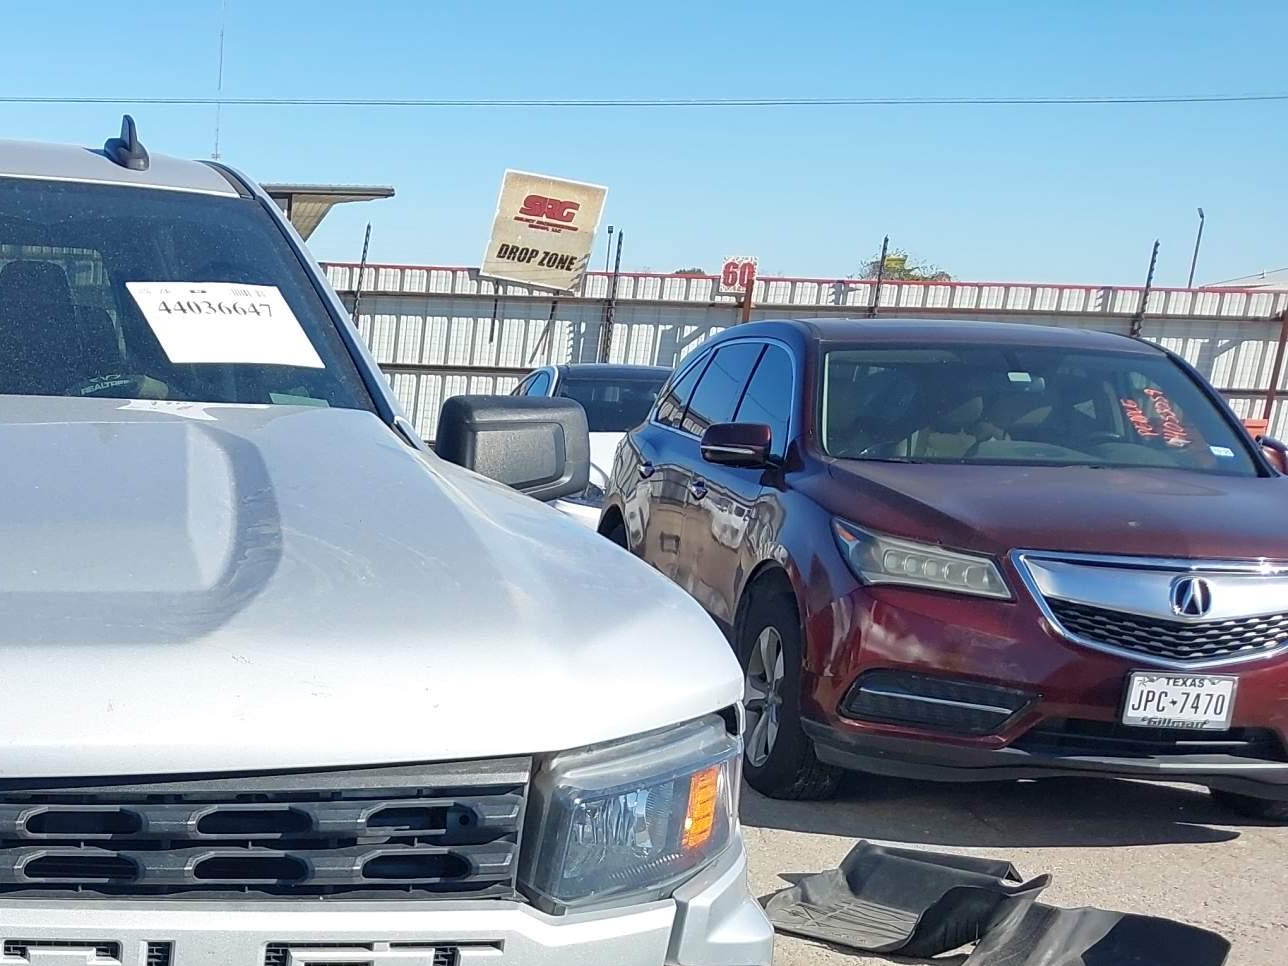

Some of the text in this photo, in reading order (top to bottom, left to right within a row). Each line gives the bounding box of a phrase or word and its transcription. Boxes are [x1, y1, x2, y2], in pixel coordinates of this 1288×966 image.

[518, 194, 581, 223] SRG
[495, 243, 578, 272] DROP ZONE
[722, 261, 756, 288] 60
[158, 299, 273, 318] 44036647
[1165, 676, 1206, 689] TEXAS
